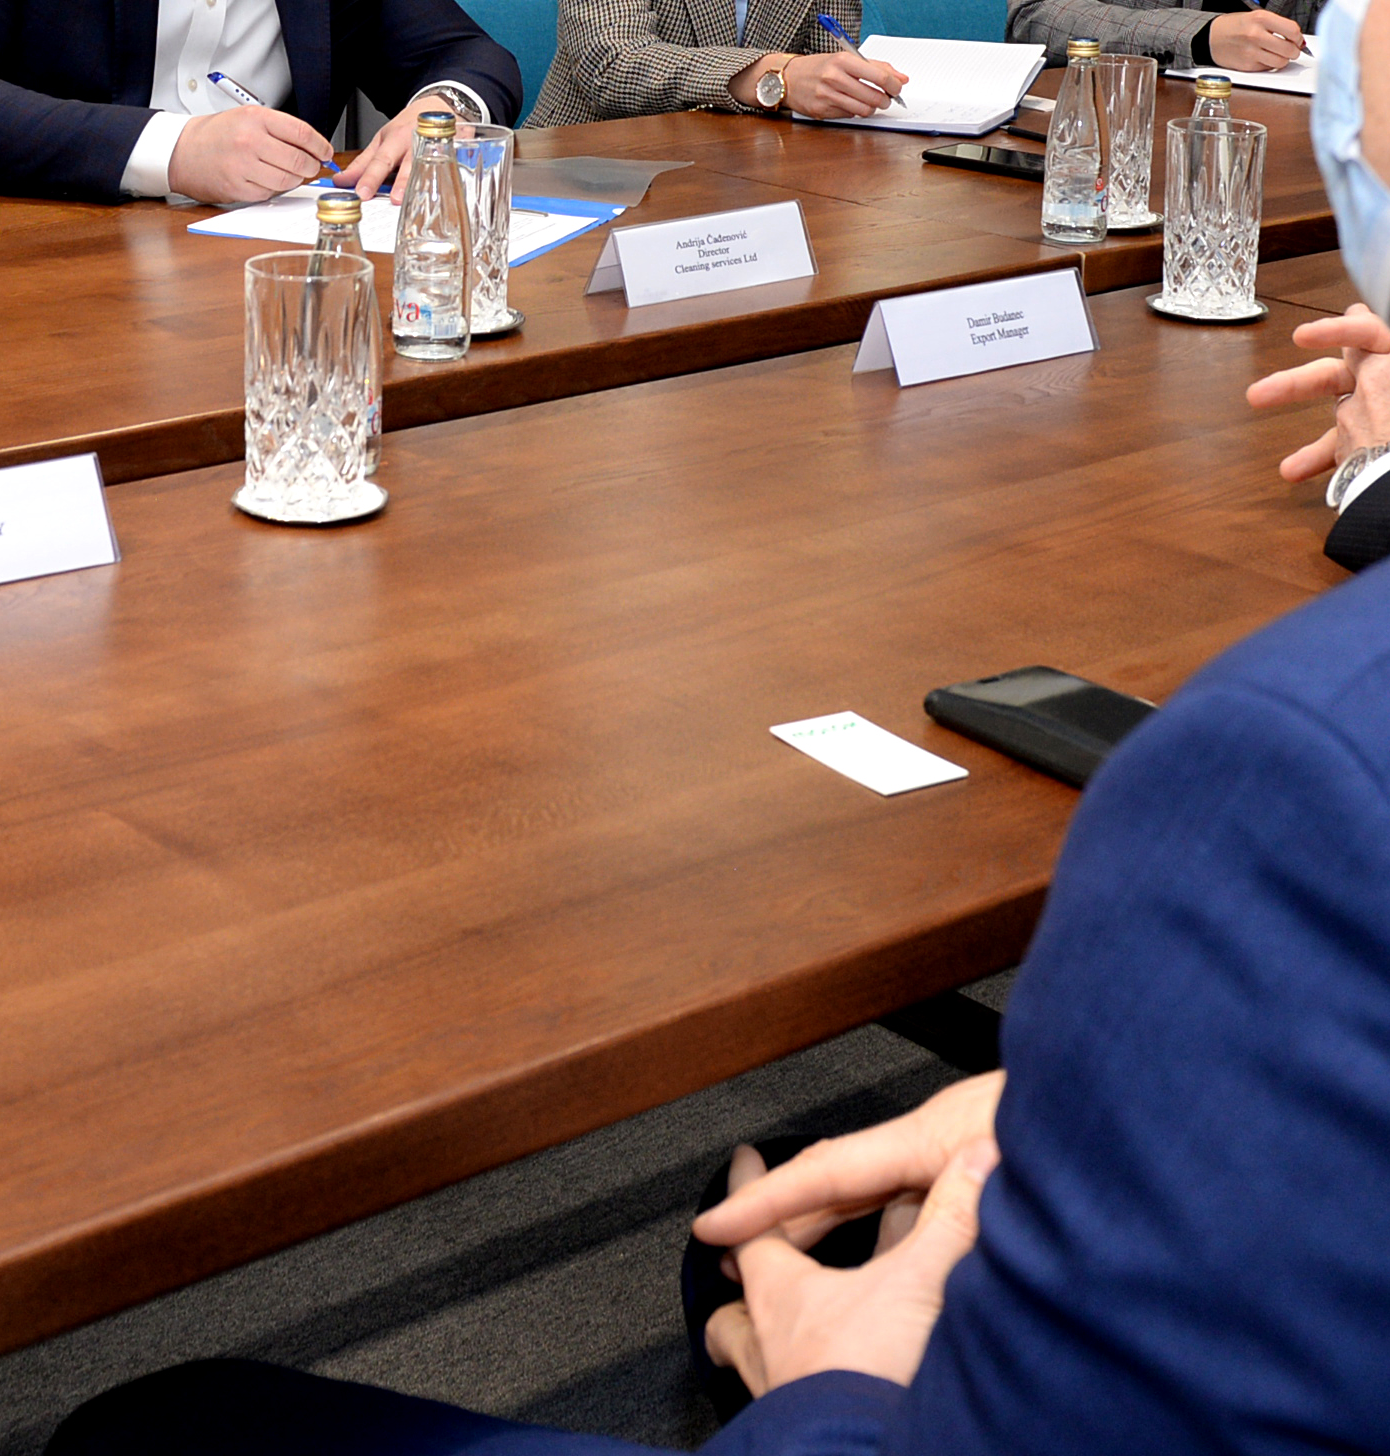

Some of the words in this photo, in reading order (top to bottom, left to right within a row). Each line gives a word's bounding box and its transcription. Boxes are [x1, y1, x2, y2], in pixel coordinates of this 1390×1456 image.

[676, 237, 705, 249] Andrija
[698, 247, 730, 258] Director
[674, 261, 710, 274] Cleaning
[711, 256, 742, 268] services
[743, 252, 758, 263] Ltd
[966, 313, 992, 329] Damir
[970, 331, 997, 346] Export
[996, 326, 1030, 340] Manager
